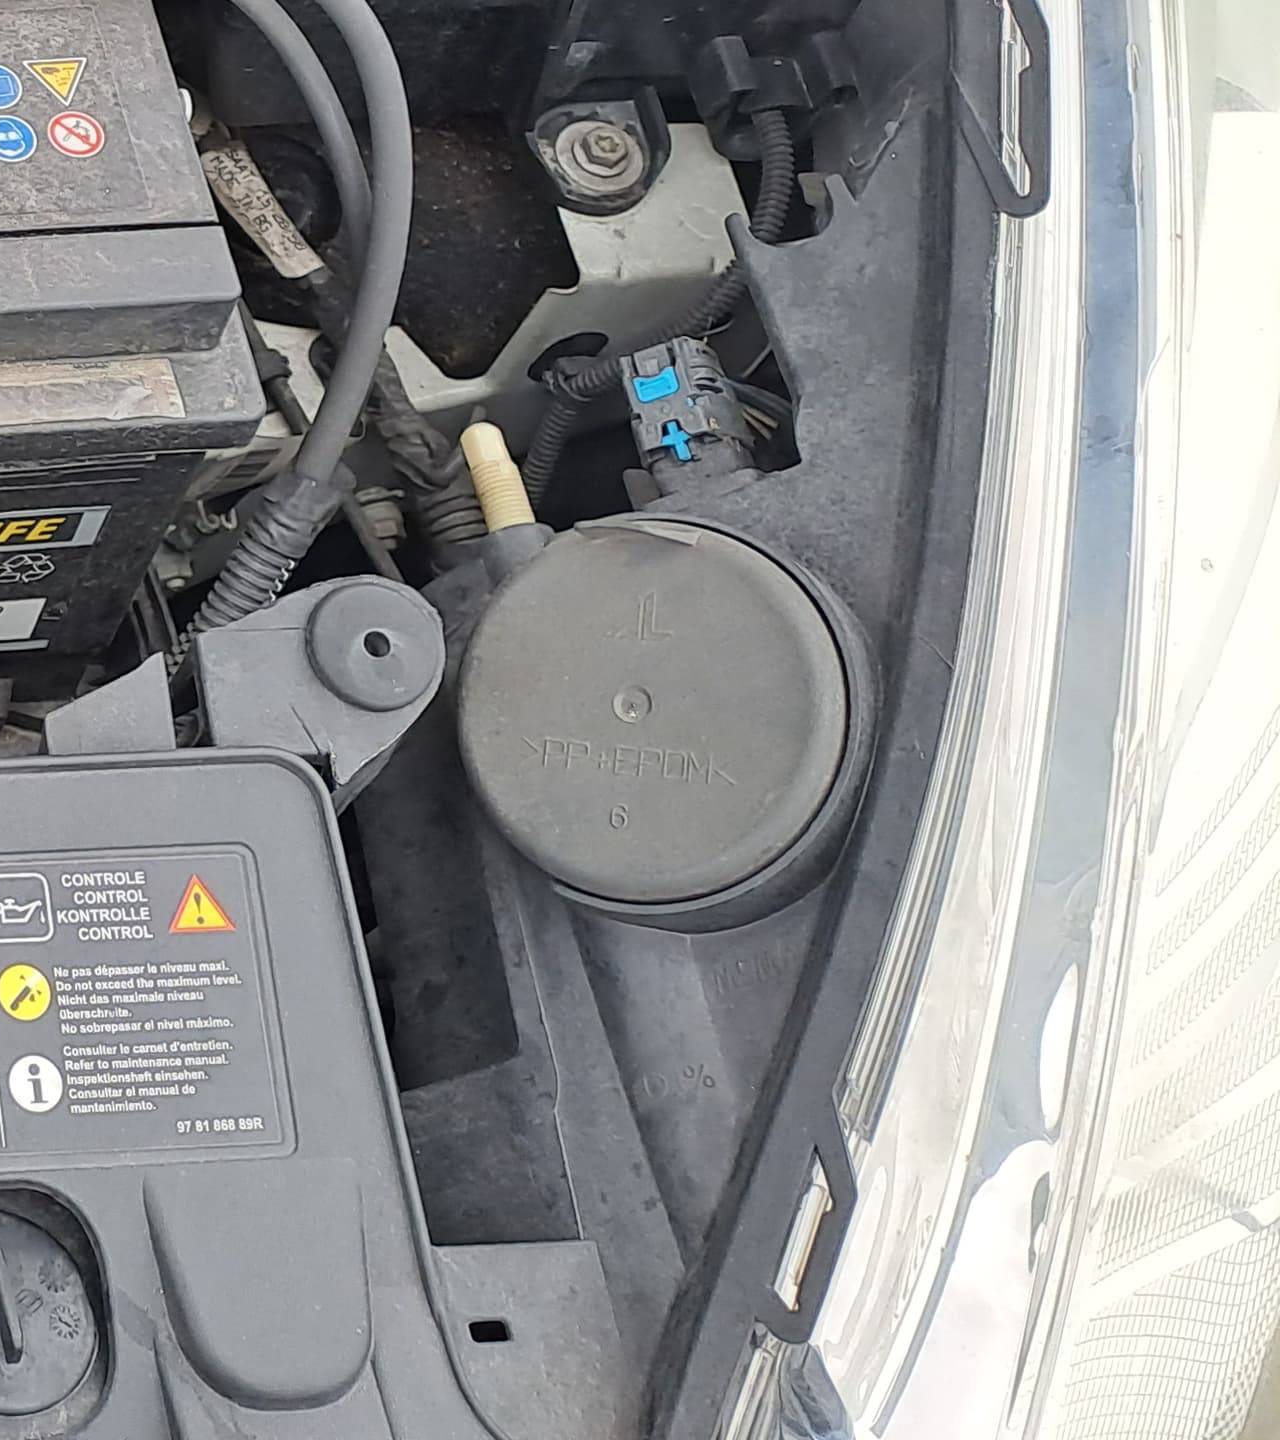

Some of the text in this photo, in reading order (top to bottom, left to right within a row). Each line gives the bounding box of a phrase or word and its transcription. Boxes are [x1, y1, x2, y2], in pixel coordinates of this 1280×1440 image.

[609, 803, 630, 829] 6
[61, 871, 146, 888] CONTROLE
[73, 889, 149, 905] CONTROL
[56, 907, 151, 924] KONTROLLE
[78, 924, 154, 941] CONTROL
[53, 959, 229, 980] Ne pas dépasser le niveau maxi.
[55, 972, 242, 992] Do not exceed the maximum level.
[61, 1022, 77, 1035] No
[79, 1020, 142, 1036] sobrepasar
[144, 1019, 154, 1031] el
[156, 1018, 184, 1031] nivel
[62, 1043, 117, 1056] Consulter
[119, 1042, 129, 1054] le
[169, 1038, 232, 1052] d'entretien.
[64, 1053, 228, 1071] Refer to maintenance manual.
[176, 1117, 263, 1133] 97 81 868 89R
